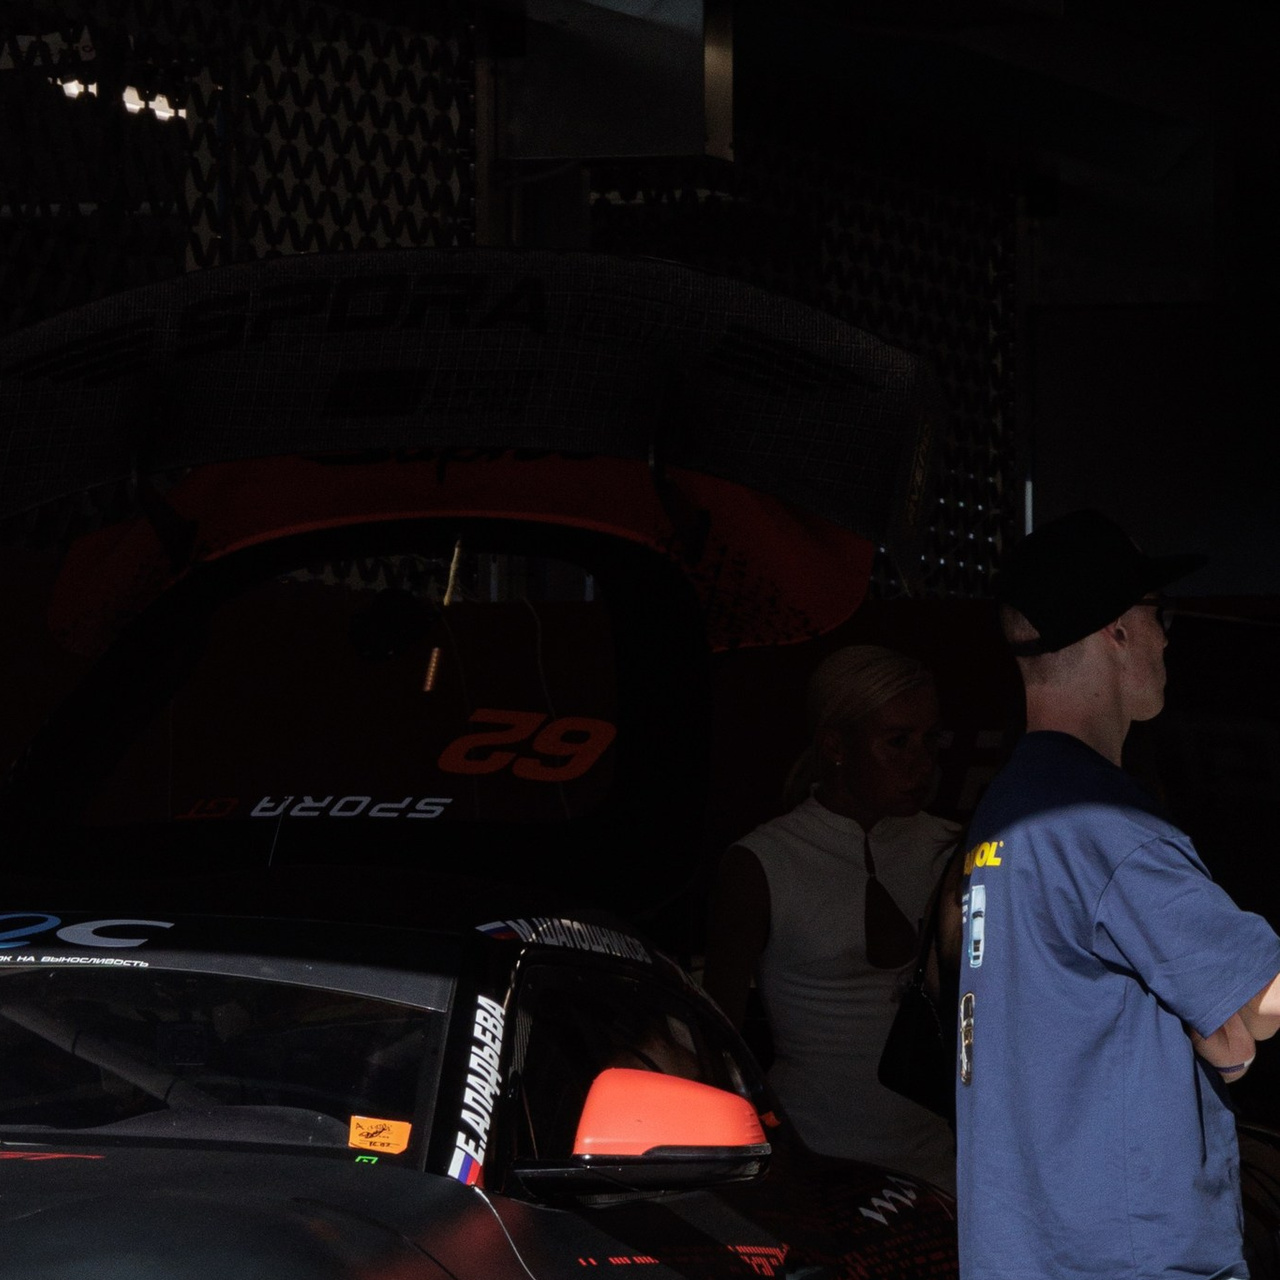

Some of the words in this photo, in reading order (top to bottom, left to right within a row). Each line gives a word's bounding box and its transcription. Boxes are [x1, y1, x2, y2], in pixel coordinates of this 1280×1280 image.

[16, 955, 36, 963] НА
[40, 955, 150, 967] ВЫНОСЛИВОСТЬ
[455, 994, 507, 1167] Е.АЛАДЬЕВА
